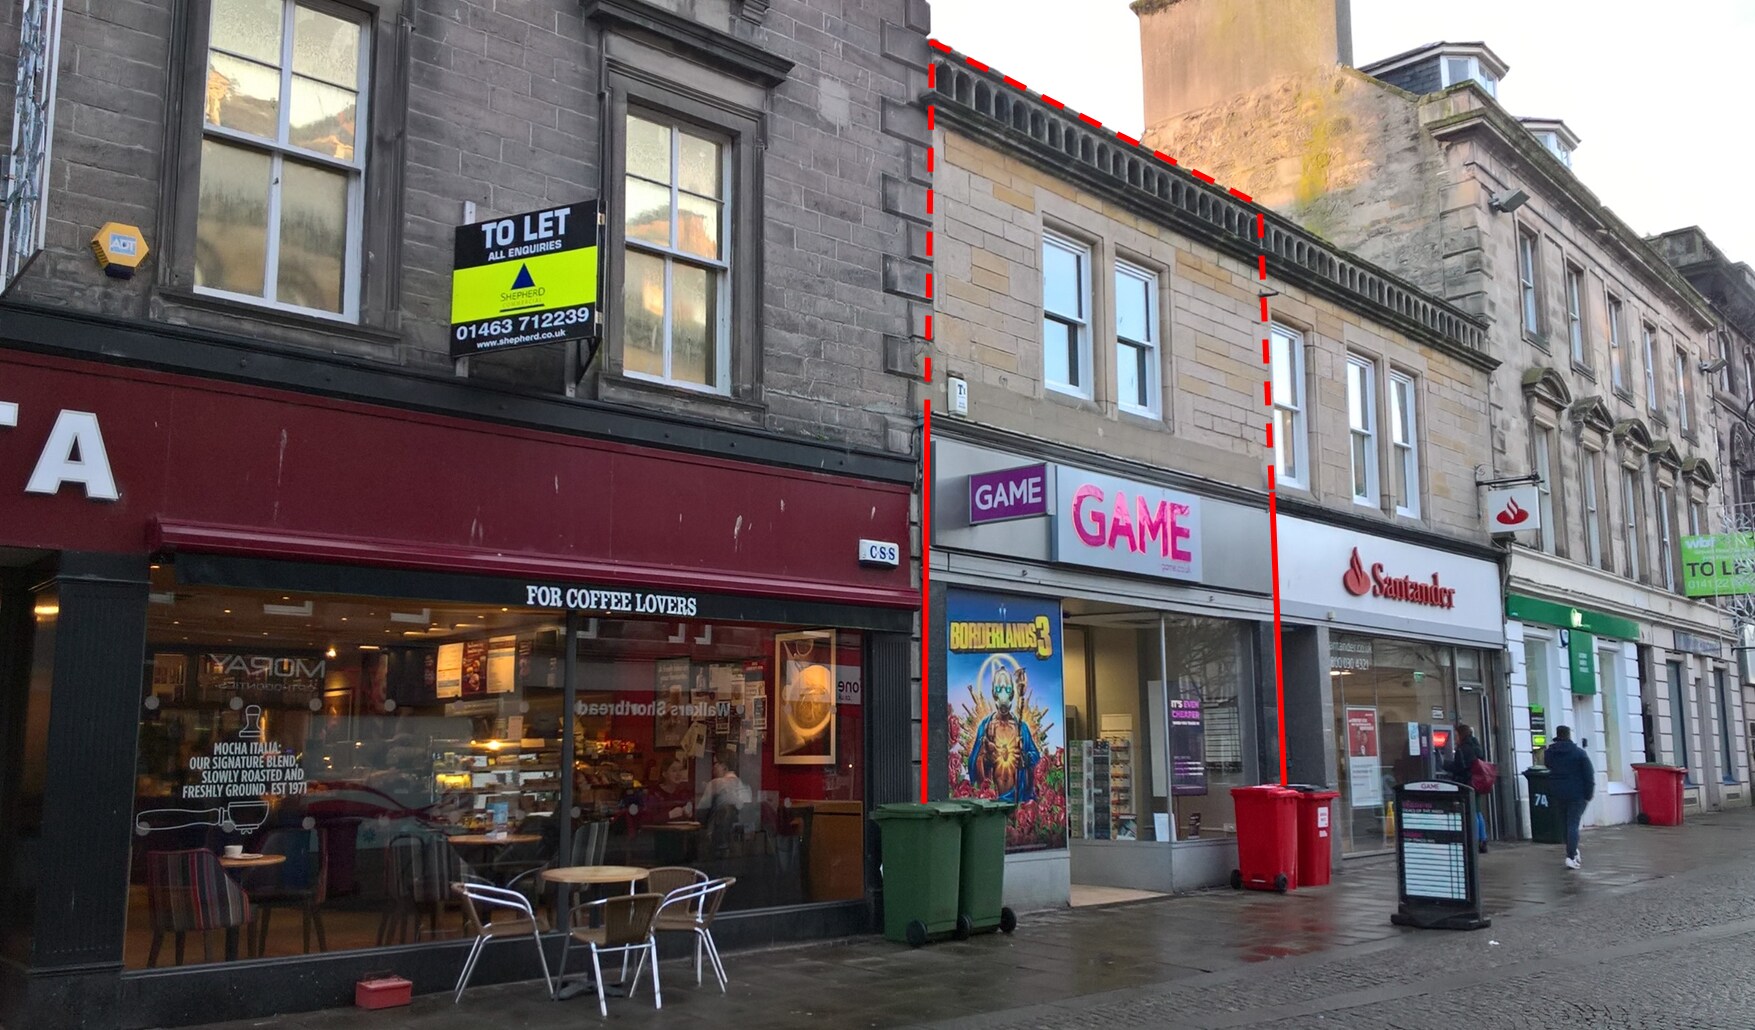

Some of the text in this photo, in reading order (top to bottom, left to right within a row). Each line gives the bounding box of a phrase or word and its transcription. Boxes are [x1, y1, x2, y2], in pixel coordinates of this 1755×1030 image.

[482, 207, 571, 248] TO LET
[111, 237, 136, 251] ADT
[488, 239, 562, 261] ALL ENQUIRIES
[500, 287, 545, 301] SHEPHERD
[456, 307, 589, 340] 01463 712239
[477, 328, 566, 348] www.shepherd.co.uk
[975, 476, 1042, 510] GAME
[1072, 483, 1192, 563] GAME
[1686, 562, 1714, 577] TO
[1372, 562, 1456, 610] Santander
[526, 585, 697, 616] FOR COFFEE LOVERS
[949, 615, 1053, 658] BORDERLANDS 3
[213, 741, 282, 755] MOCHA ITALIA:
[189, 755, 299, 769] OUR SIGNATURE BLEND,
[201, 767, 304, 783] SLOWLY ROASTED AND
[182, 781, 307, 798] FRESHLY GROUND. EST 1971
[1535, 794, 1548, 807] 74
